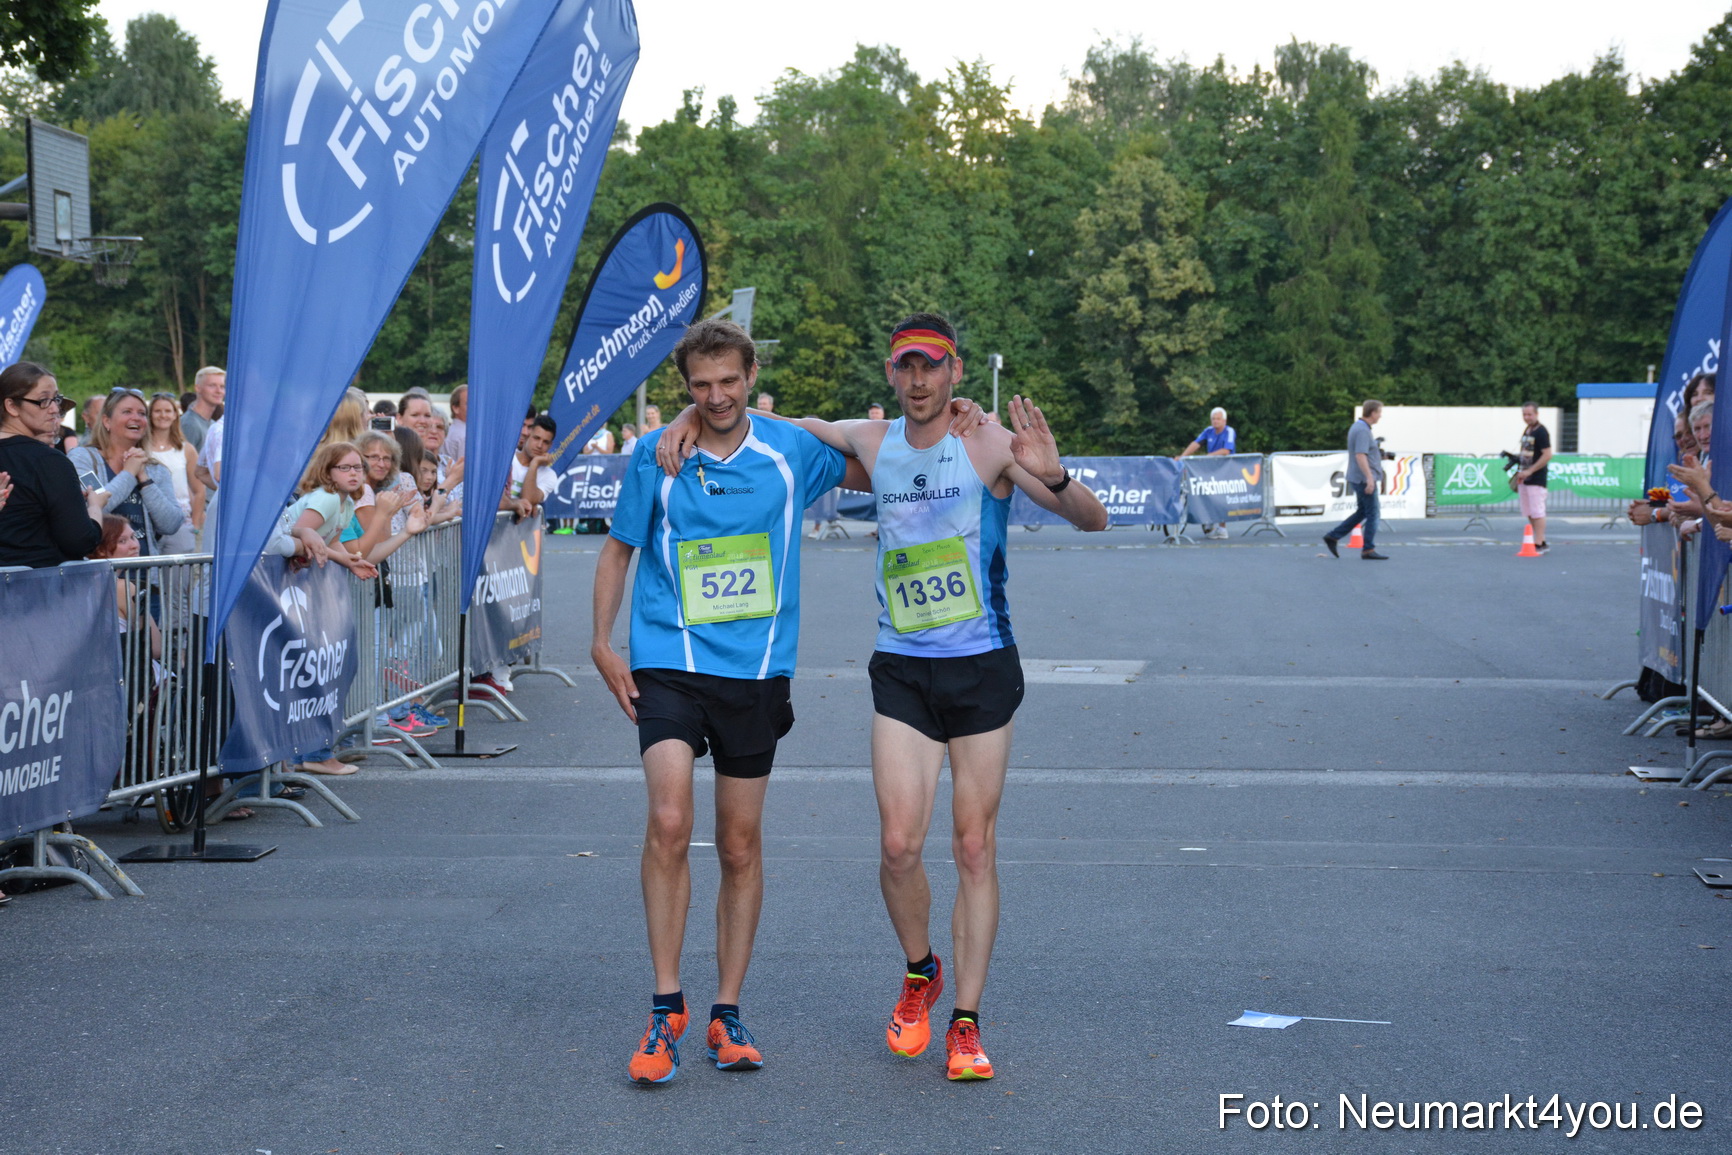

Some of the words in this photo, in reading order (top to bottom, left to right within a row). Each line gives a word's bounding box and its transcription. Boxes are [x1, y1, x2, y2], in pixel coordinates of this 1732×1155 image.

[327, 0, 459, 190] Fisc
[513, 7, 600, 262] Fischer
[627, 326, 652, 359] Druck
[668, 282, 698, 324] Medien
[564, 294, 664, 403] Frischmann
[726, 486, 755, 495] classic
[1189, 477, 1248, 496] Frischmann
[1444, 462, 1492, 488] AOK
[579, 500, 618, 509] AUTOM
[882, 486, 960, 504] SCHABMÜLLER
[476, 561, 529, 606] rischmann
[702, 568, 757, 599] 522
[896, 571, 966, 608] 1336
[713, 602, 735, 611] Michael
[735, 600, 749, 608] Lang
[916, 611, 932, 619] Daniel
[932, 607, 951, 616] Schön
[280, 631, 347, 692] Fischer
[0, 680, 73, 754] cher
